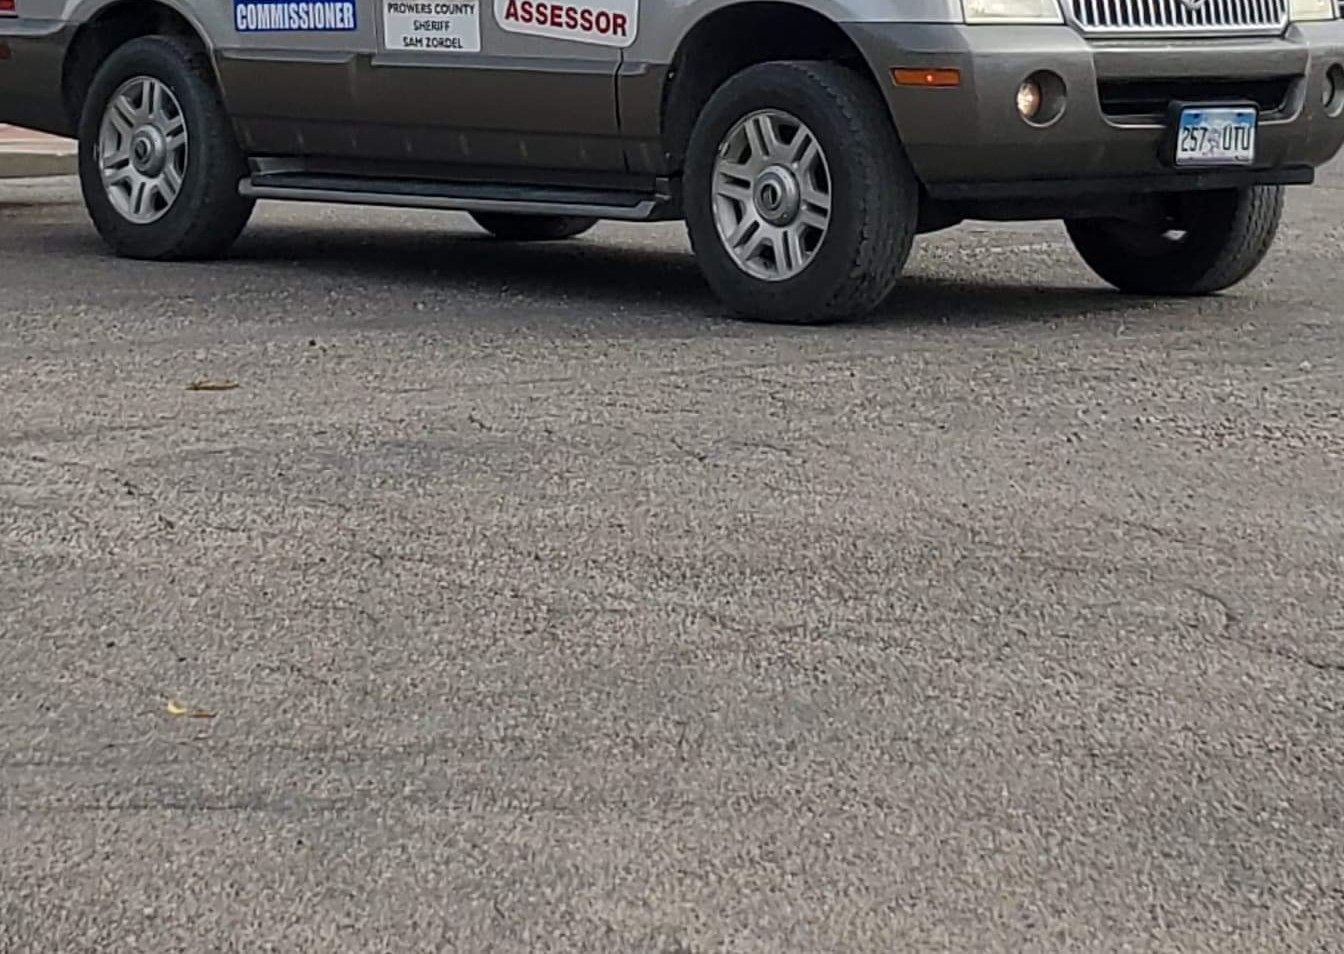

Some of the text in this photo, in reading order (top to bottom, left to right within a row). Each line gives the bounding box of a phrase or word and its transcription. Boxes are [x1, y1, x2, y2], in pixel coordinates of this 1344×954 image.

[236, 3, 355, 29] COMMISSIONER
[387, 3, 475, 14] PROWERS COUNTY
[413, 20, 450, 31] SHERIFF
[504, 0, 627, 36] ASSESSOR
[402, 36, 423, 47] SAM
[1181, 126, 1208, 152] 257
